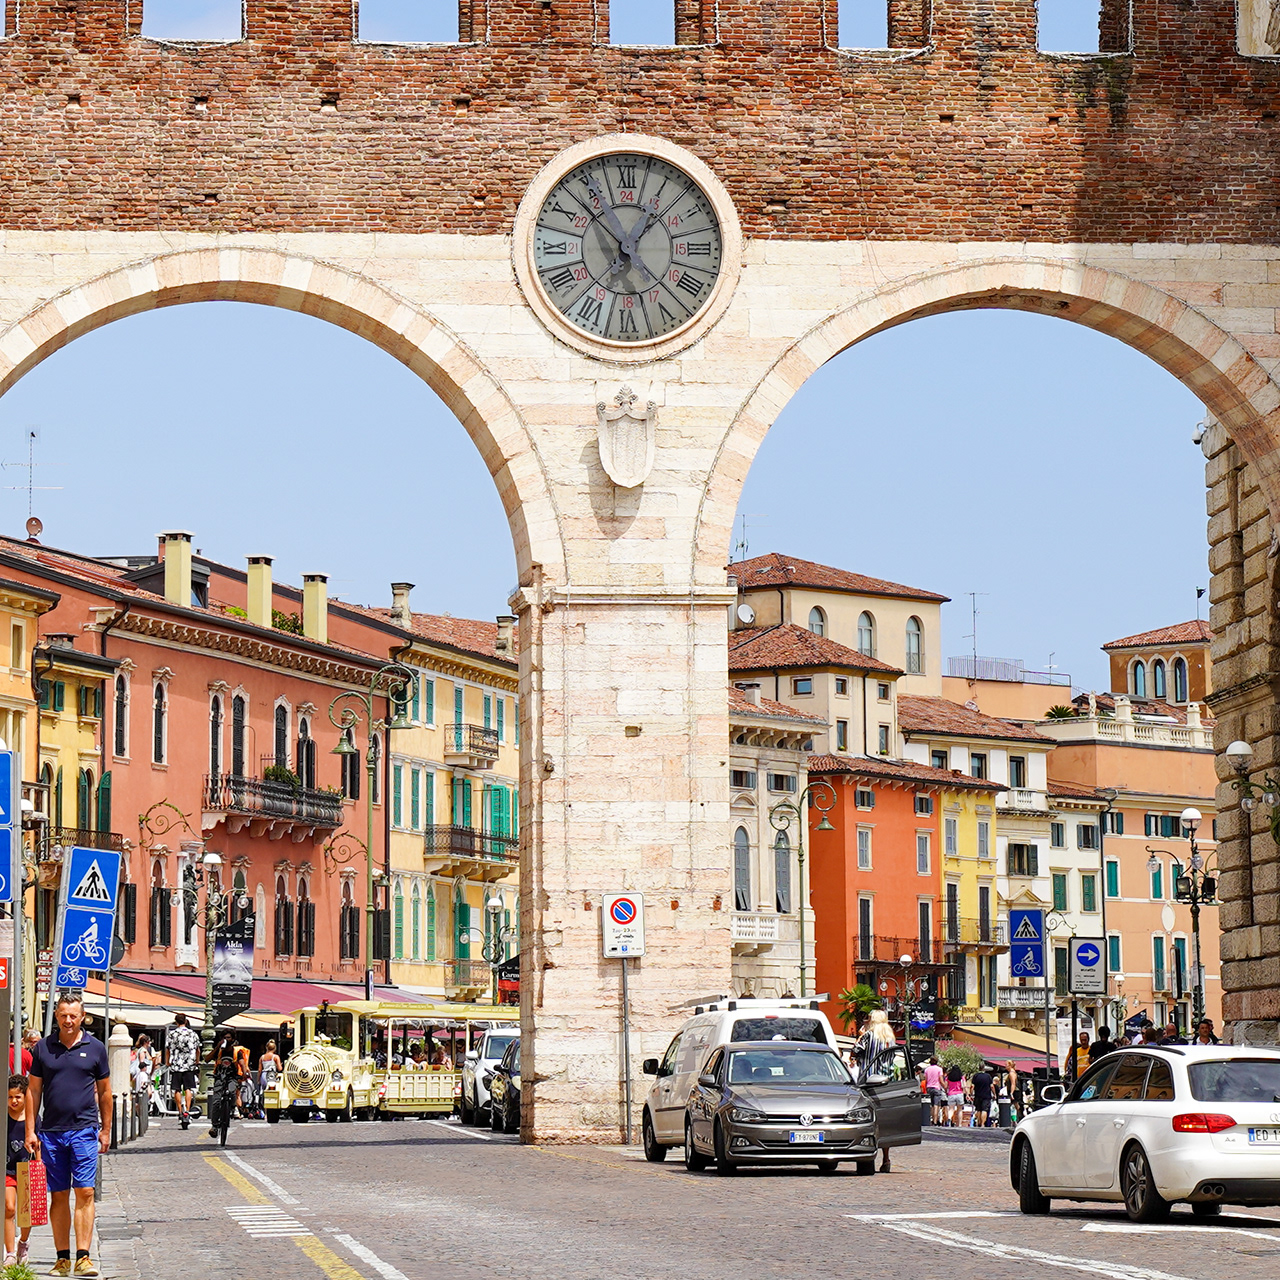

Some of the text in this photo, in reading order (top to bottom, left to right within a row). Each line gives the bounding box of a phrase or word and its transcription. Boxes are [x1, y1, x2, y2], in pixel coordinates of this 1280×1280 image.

[616, 165, 637, 188] XII
[620, 190, 634, 203] 24
[552, 201, 577, 222] X
[574, 216, 587, 228] 22
[668, 216, 679, 227] 14
[568, 243, 578, 254] 21
[675, 244, 687, 255] 15
[687, 242, 711, 256] III
[574, 267, 588, 281] 20
[669, 269, 680, 282] 16
[595, 287, 606, 300] 19
[649, 290, 660, 302] 17
[622, 296, 634, 308] 18
[658, 301, 676, 325] V
[619, 309, 639, 333] VI
